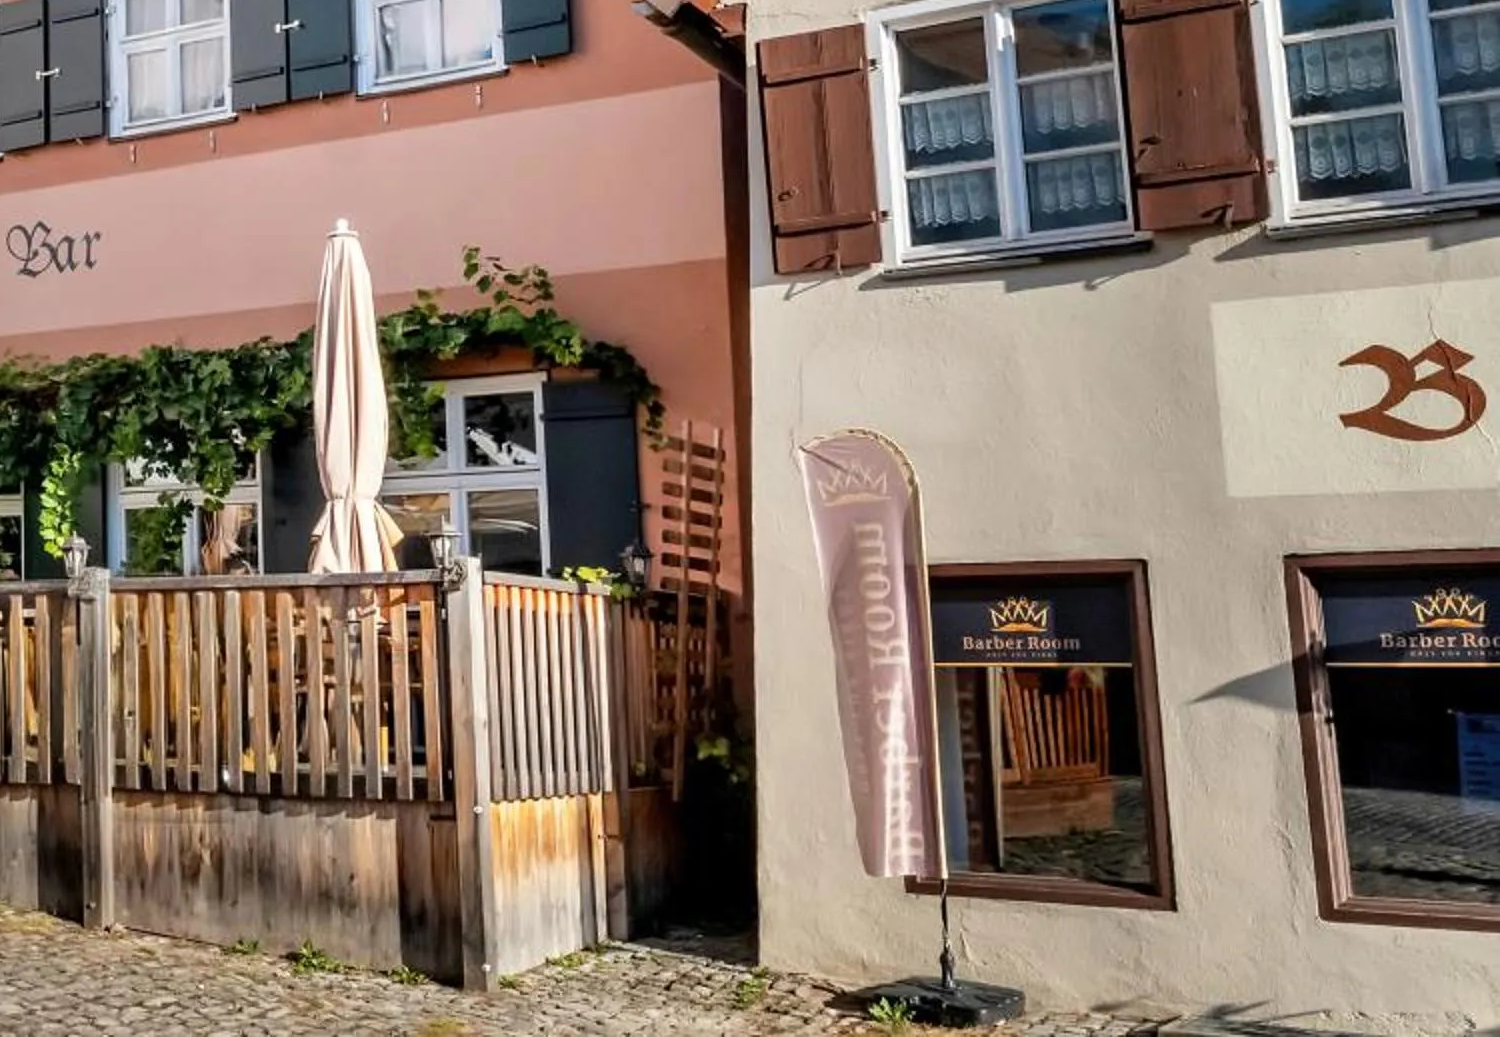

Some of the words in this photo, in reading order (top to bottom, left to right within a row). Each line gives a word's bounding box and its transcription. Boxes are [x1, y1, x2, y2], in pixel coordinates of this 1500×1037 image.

[6, 220, 102, 278] Bar
[963, 636, 1023, 650] Barber
[1027, 636, 1081, 650] Room
[1380, 632, 1457, 648] Barber
